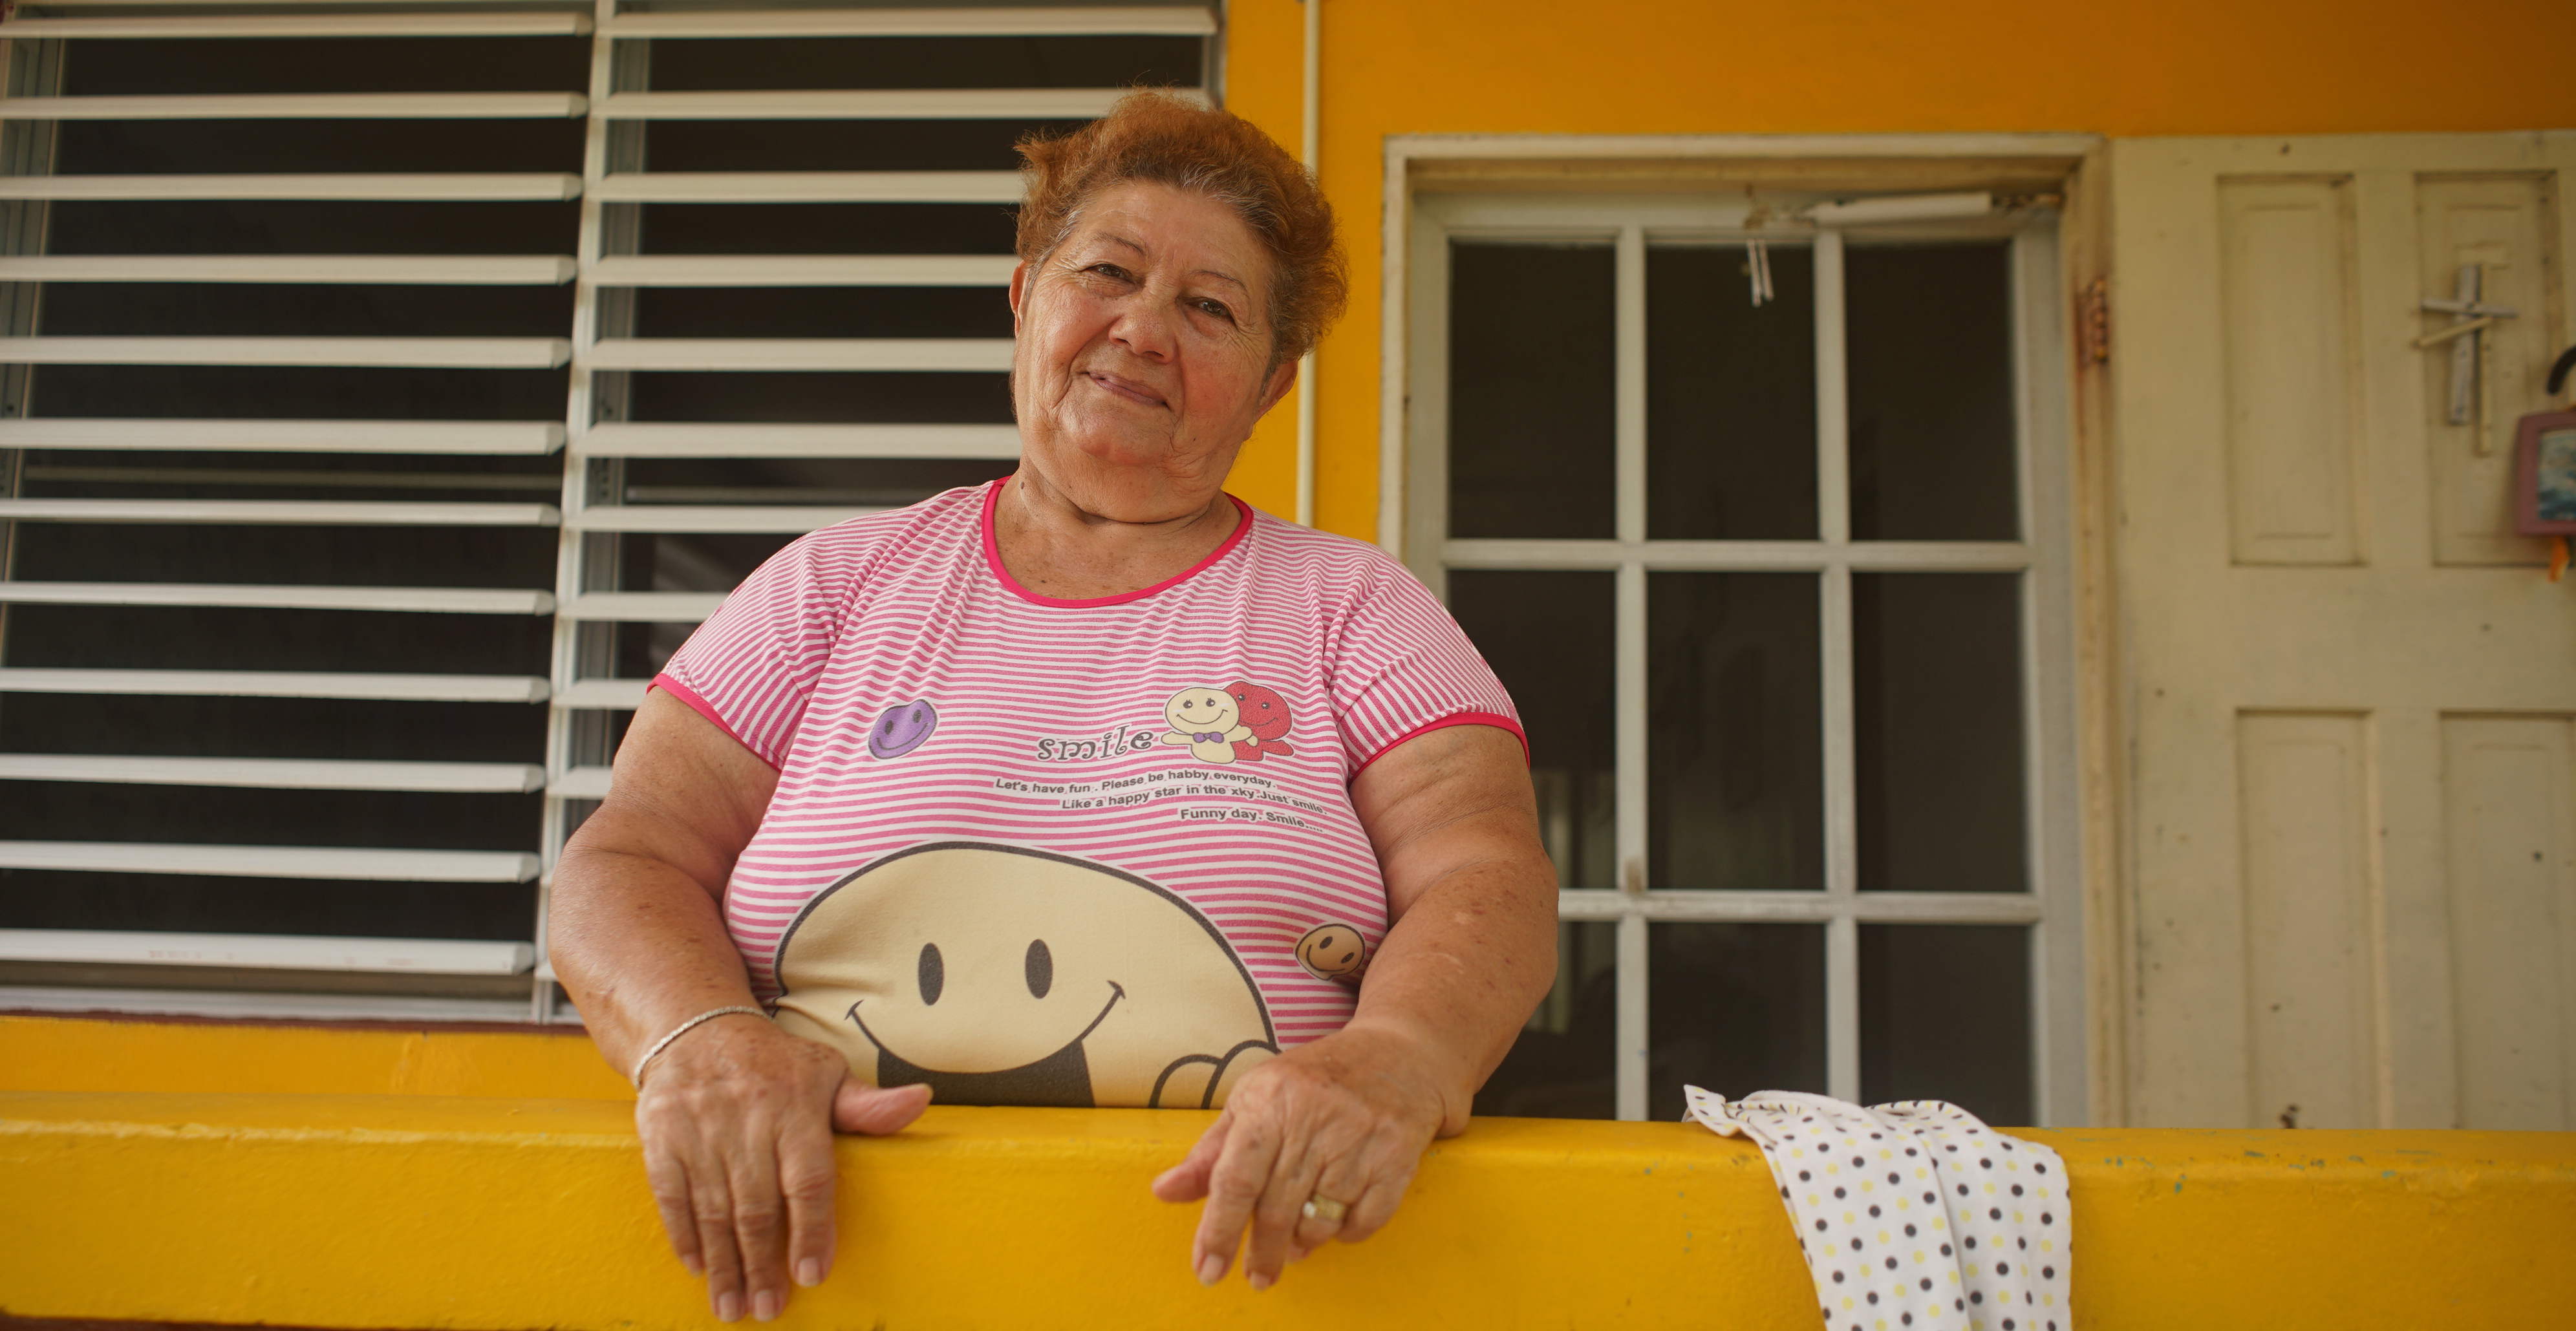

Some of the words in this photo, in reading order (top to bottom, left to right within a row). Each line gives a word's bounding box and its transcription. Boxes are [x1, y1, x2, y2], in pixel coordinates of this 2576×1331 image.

[1037, 724, 1154, 760] smile
[996, 778, 1028, 792] Let's
[1033, 783, 1064, 793] have
[1102, 776, 1144, 791] Please
[1148, 773, 1164, 782] be
[1168, 770, 1209, 781] habby
[1214, 771, 1276, 788] everyday.
[1062, 799, 1091, 809] Like
[1108, 792, 1150, 805] happy
[1155, 787, 1182, 798] star
[1186, 785, 1199, 794] in
[1203, 785, 1226, 794] the
[1292, 798, 1327, 815] smile.
[1180, 809, 1227, 820] Funny
[1231, 809, 1262, 821] day.
